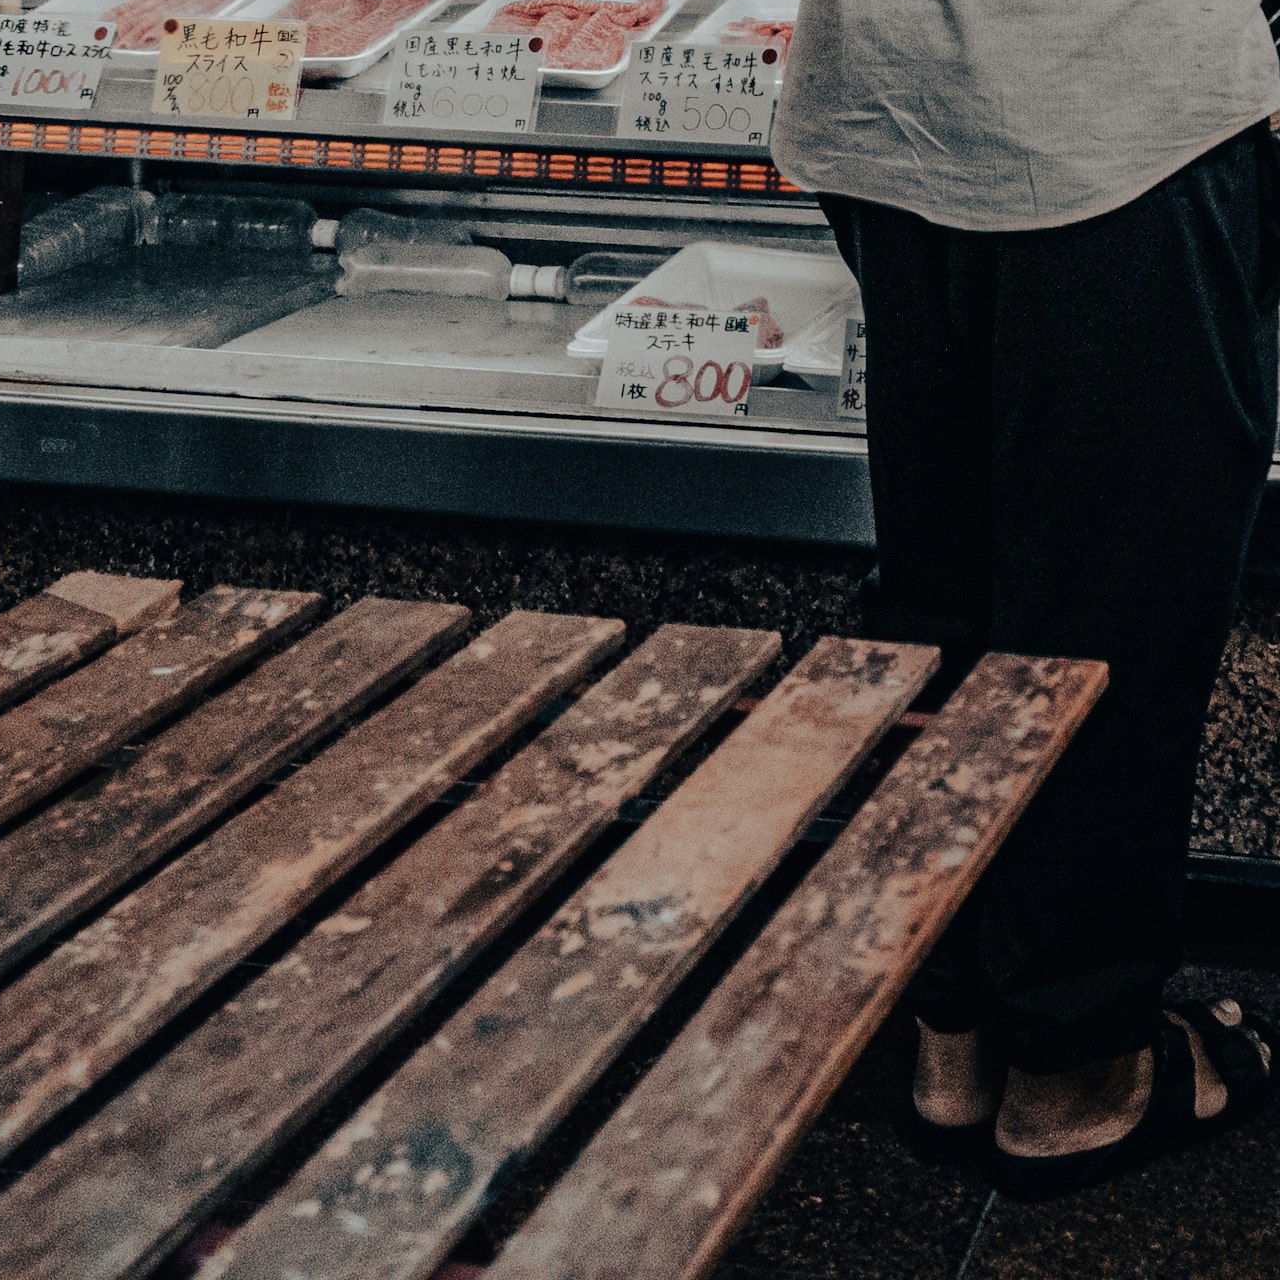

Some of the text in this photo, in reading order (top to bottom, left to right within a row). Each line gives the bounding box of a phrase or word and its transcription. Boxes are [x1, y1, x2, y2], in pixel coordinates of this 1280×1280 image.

[177, 23, 273, 56] 黒毛和牛
[405, 37, 525, 59] 国産黒毛和牛
[185, 54, 249, 73] スライス
[638, 44, 759, 74] 国産黒毛和牛
[639, 69, 700, 88] スライス
[399, 79, 423, 100] 100g
[392, 99, 427, 119] 税込
[641, 90, 668, 116] 100g
[634, 114, 671, 133] 税込
[646, 332, 696, 352] ステーキ
